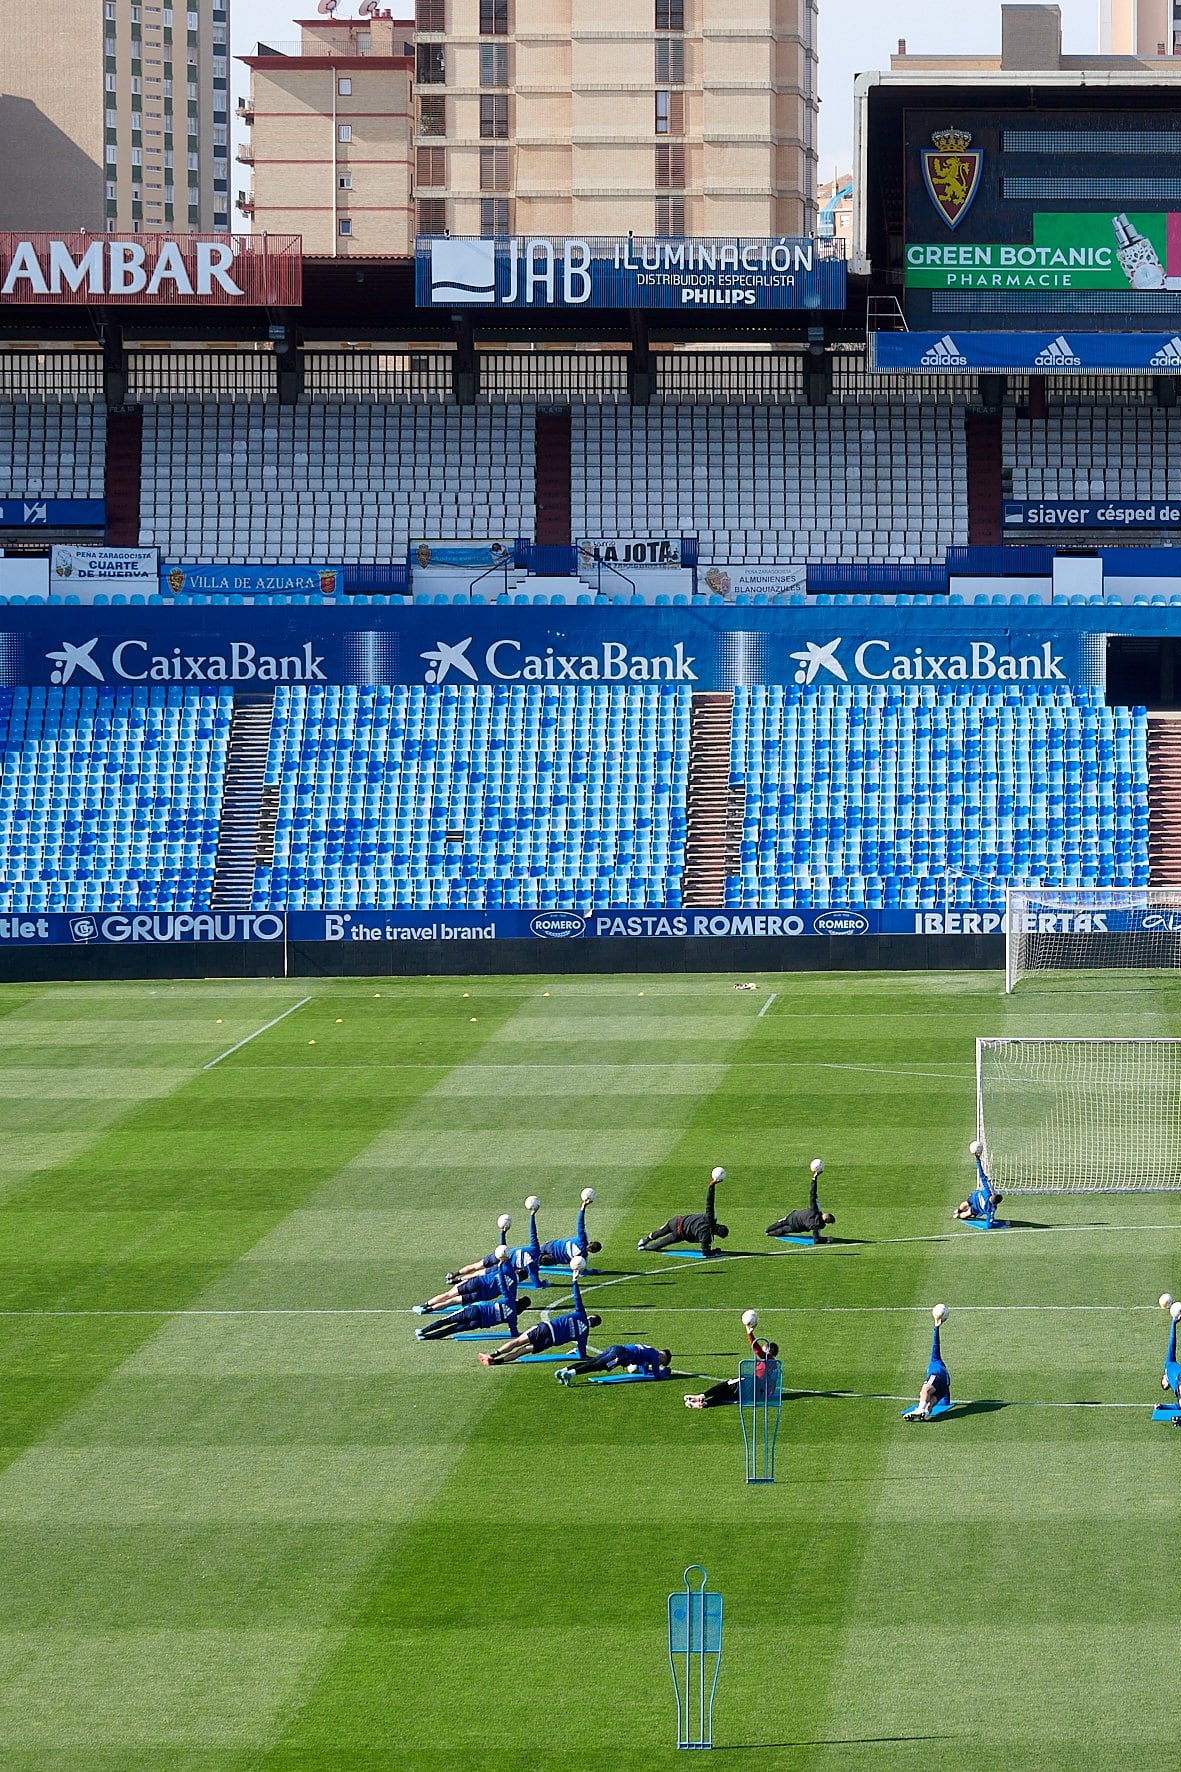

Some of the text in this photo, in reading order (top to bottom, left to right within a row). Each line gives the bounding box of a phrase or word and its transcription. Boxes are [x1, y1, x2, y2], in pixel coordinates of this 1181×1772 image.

[614, 238, 813, 271] ILUMINACIÓN
[907, 246, 1112, 266] GREEN BOTANIC
[1, 241, 245, 296] AMBAR
[502, 240, 591, 304] JAB
[637, 274, 795, 286] DISTRIBUIDOR ESPECIALISTA
[947, 274, 1072, 286] PHARMACIE
[682, 289, 756, 304] PHILIPS
[921, 355, 967, 366] adidas
[1035, 355, 1081, 366] adidas
[1027, 505, 1090, 524] siaver
[1097, 505, 1155, 524] césped
[593, 541, 671, 562] LA JOTA
[89, 561, 139, 570] CUARTE
[190, 575, 315, 589] VILLA DE AZUARA
[739, 575, 797, 583] ALMUNIENSES
[112, 640, 328, 681] CaixaBank
[485, 639, 699, 680] CaixaBank
[854, 639, 1066, 680] CaixaBank
[101, 914, 284, 941] GRUPAUTO
[351, 924, 382, 941] the
[386, 923, 437, 940] travel
[441, 923, 496, 940] brand
[535, 920, 581, 930] ROMERO
[596, 915, 804, 936] PASTAS ROMERO
[818, 919, 865, 929] ROMERO
